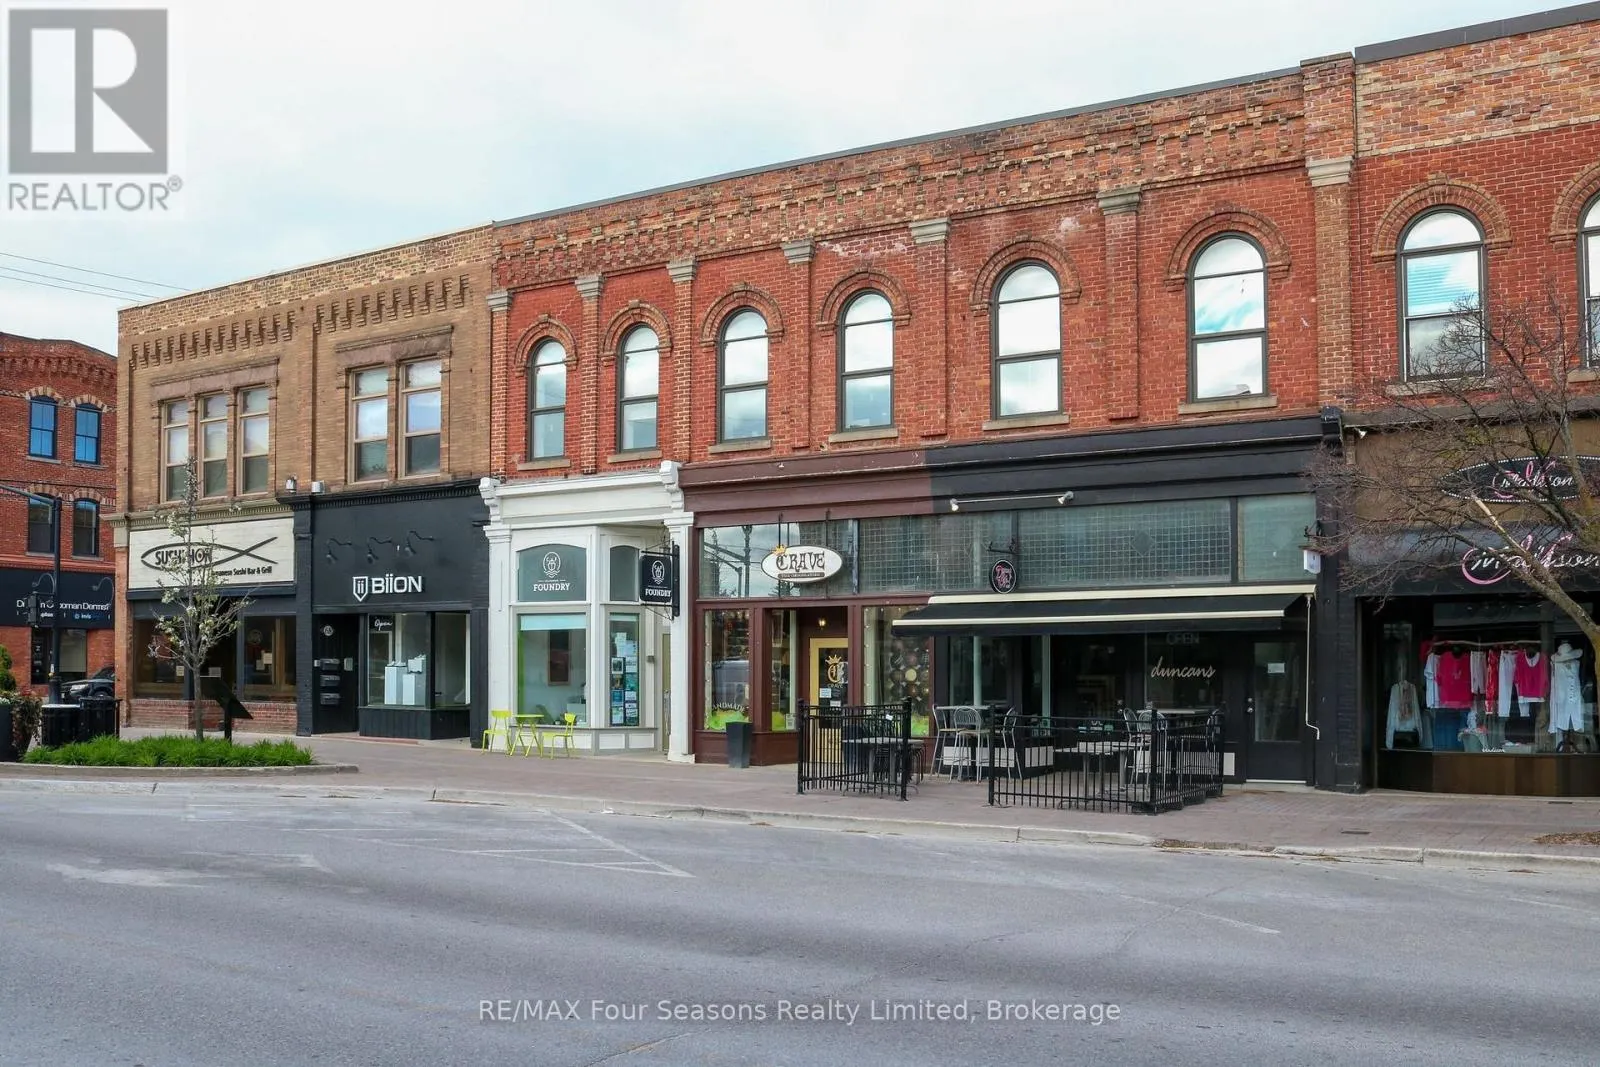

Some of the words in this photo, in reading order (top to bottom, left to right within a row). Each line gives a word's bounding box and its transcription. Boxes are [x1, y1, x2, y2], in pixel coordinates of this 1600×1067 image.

[776, 551, 825, 573] CRAVE
[533, 582, 571, 592] FOUNDRY
[374, 618, 393, 632] Open
[1150, 655, 1217, 679] duncans
